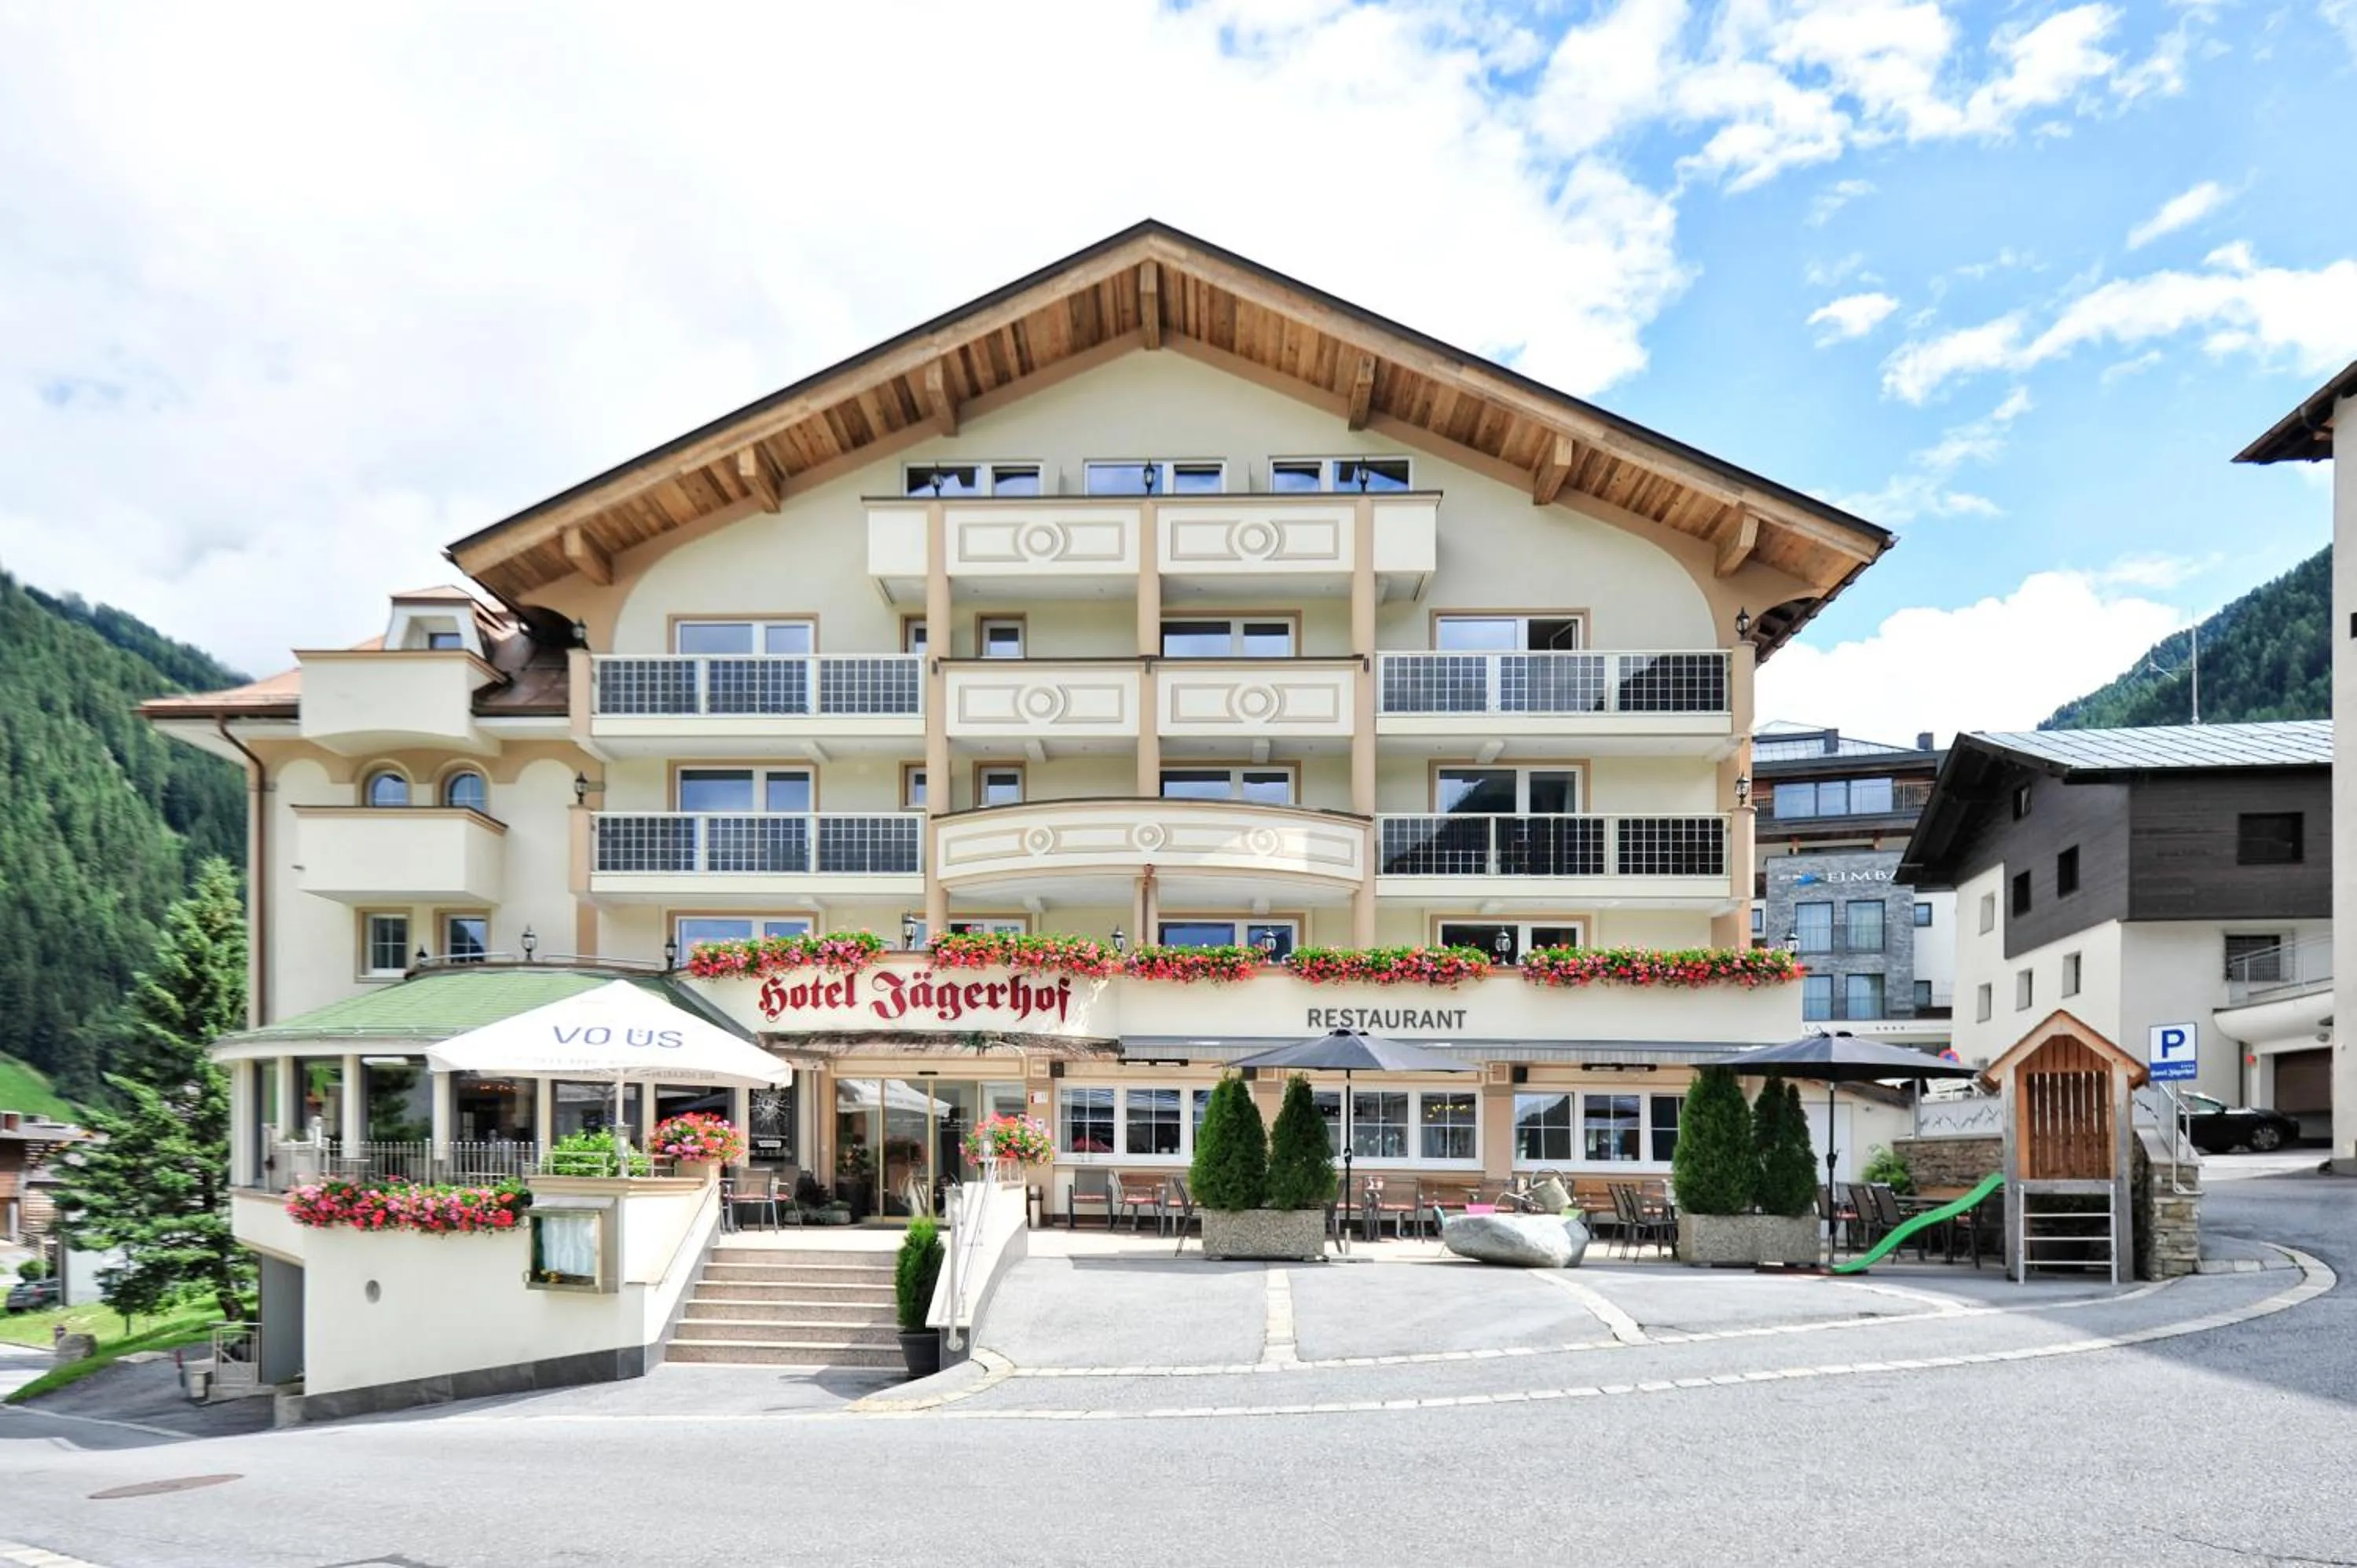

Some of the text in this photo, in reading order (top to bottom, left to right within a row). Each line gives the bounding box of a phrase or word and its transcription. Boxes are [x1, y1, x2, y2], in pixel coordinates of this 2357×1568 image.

[758, 970, 1071, 1024] Hotel Jägerhof
[1307, 1008, 1467, 1029] RESTAURANT
[2162, 1029, 2186, 1058] P
